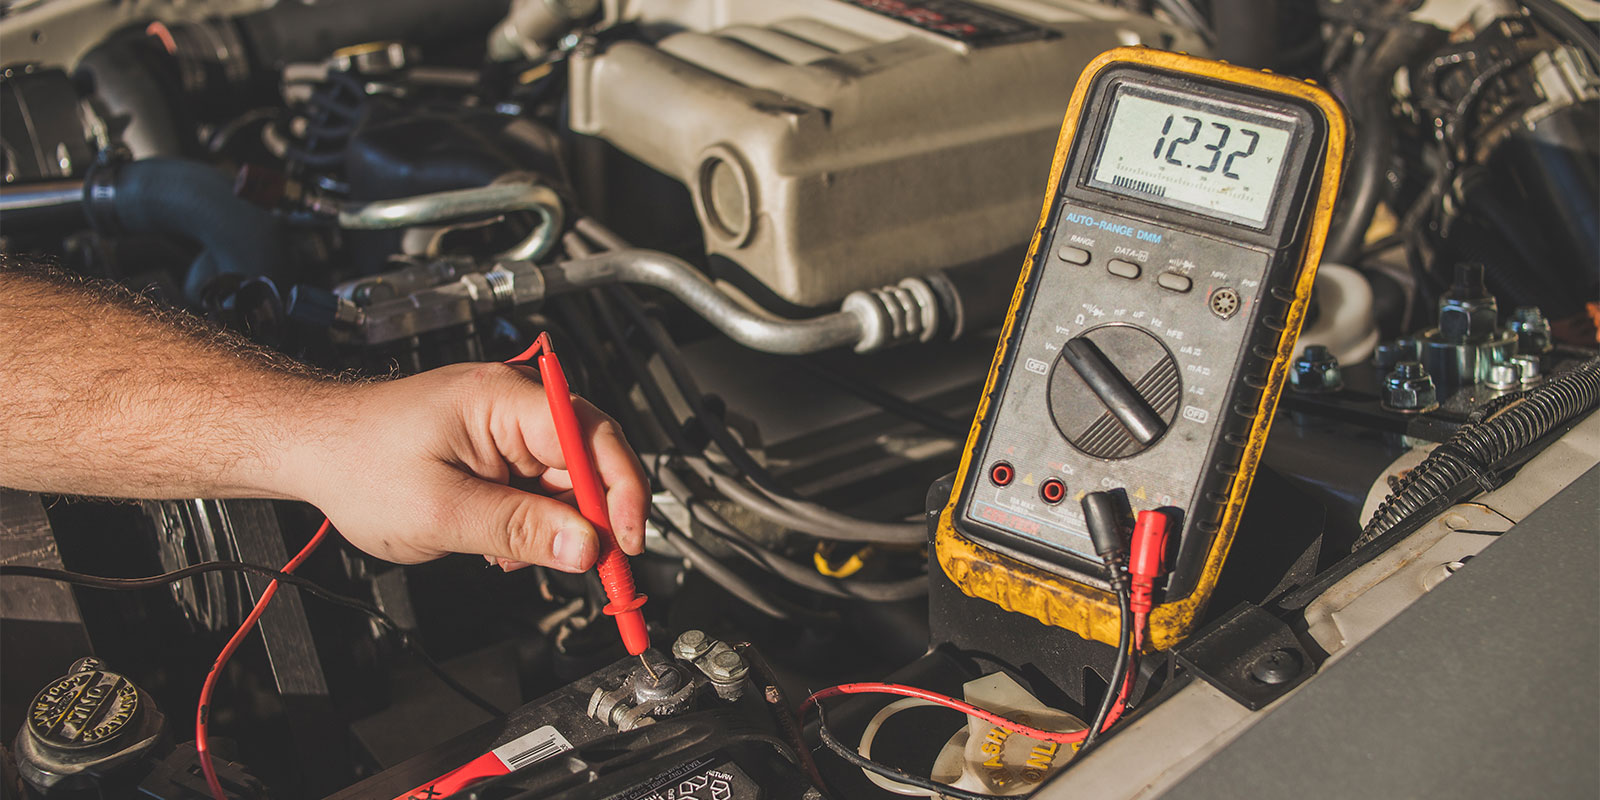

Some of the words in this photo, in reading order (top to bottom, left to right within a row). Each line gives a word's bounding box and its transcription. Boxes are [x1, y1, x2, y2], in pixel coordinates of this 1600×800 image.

[1153, 114, 1260, 180] 12.32
[1065, 212, 1134, 237] AUTO-RANGE
[1136, 230, 1162, 244] DMM
[1070, 234, 1096, 247] RANGE
[1027, 361, 1046, 373] OFF
[1186, 408, 1206, 420] OFF
[34, 675, 81, 729] COOLANT
[64, 686, 103, 724] ONLY
[705, 769, 733, 781] RETURN
